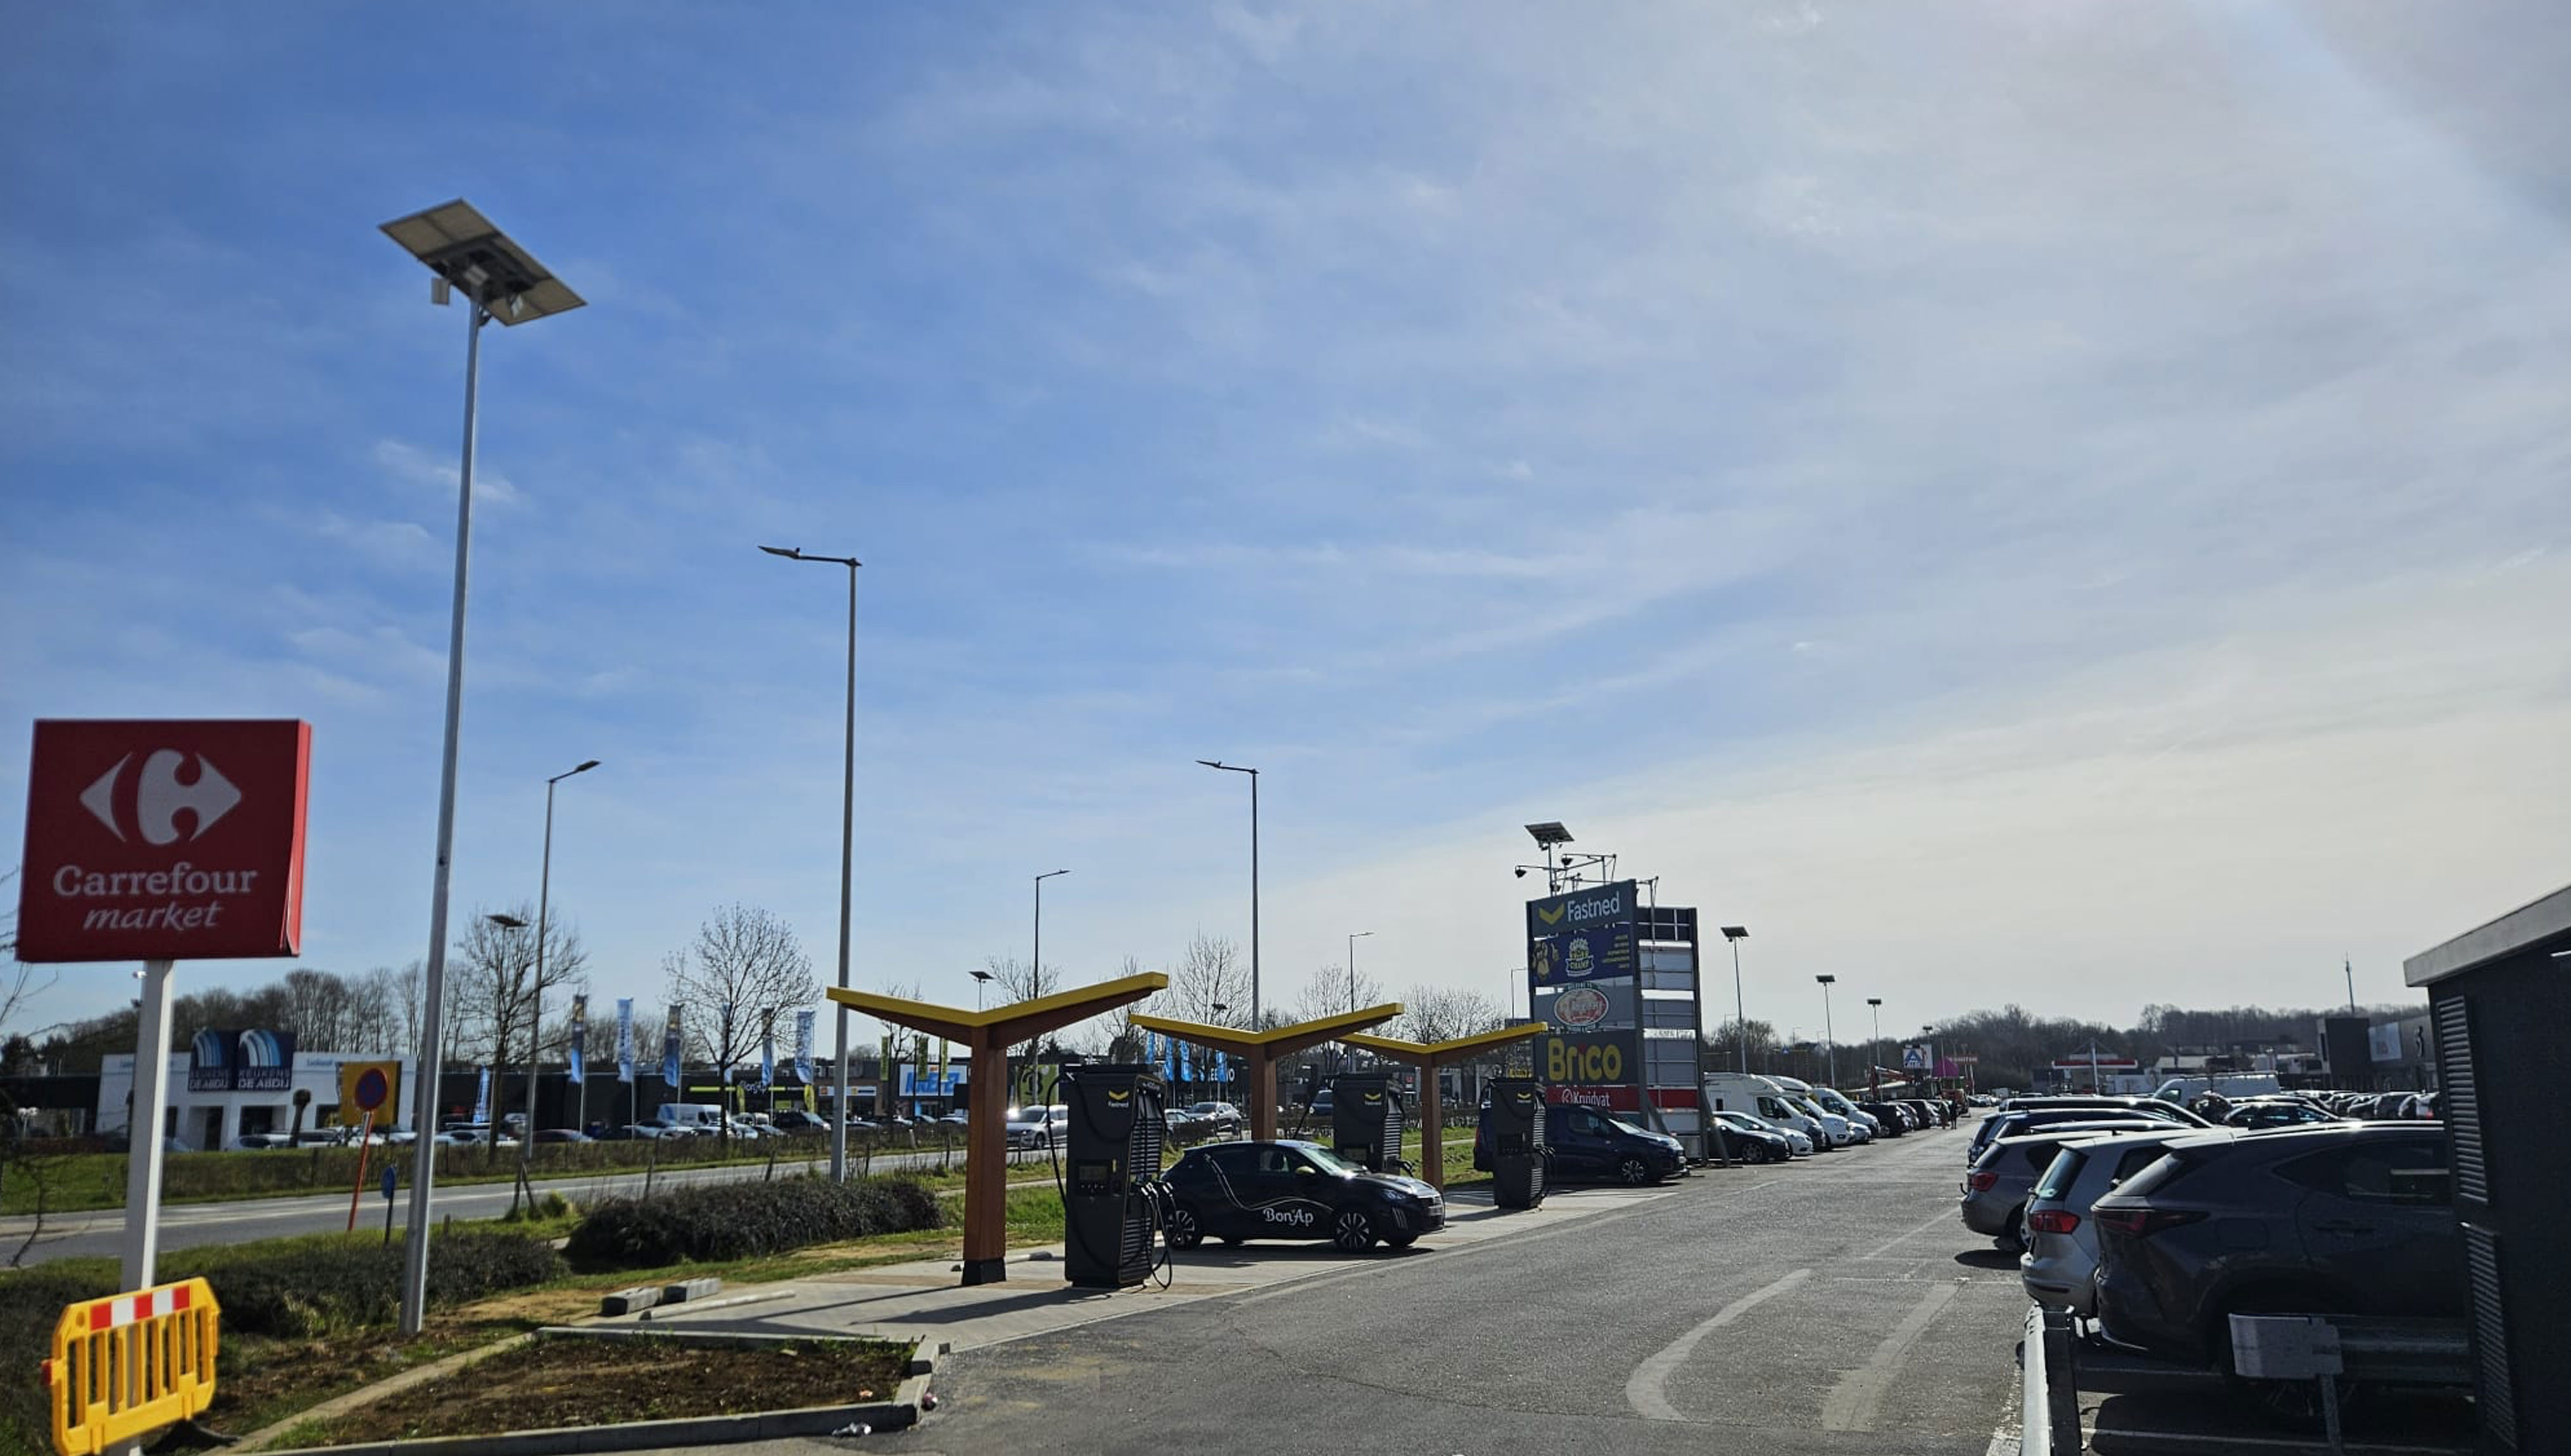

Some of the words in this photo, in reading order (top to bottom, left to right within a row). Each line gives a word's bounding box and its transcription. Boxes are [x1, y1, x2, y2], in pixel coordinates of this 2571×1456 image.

[53, 862, 258, 896] Carrefour
[82, 900, 222, 931] market
[1567, 890, 1620, 922] Fastned
[1548, 1038, 1622, 1082] Brico
[237, 1078, 254, 1088] DE
[256, 1078, 289, 1088] ABDIJ
